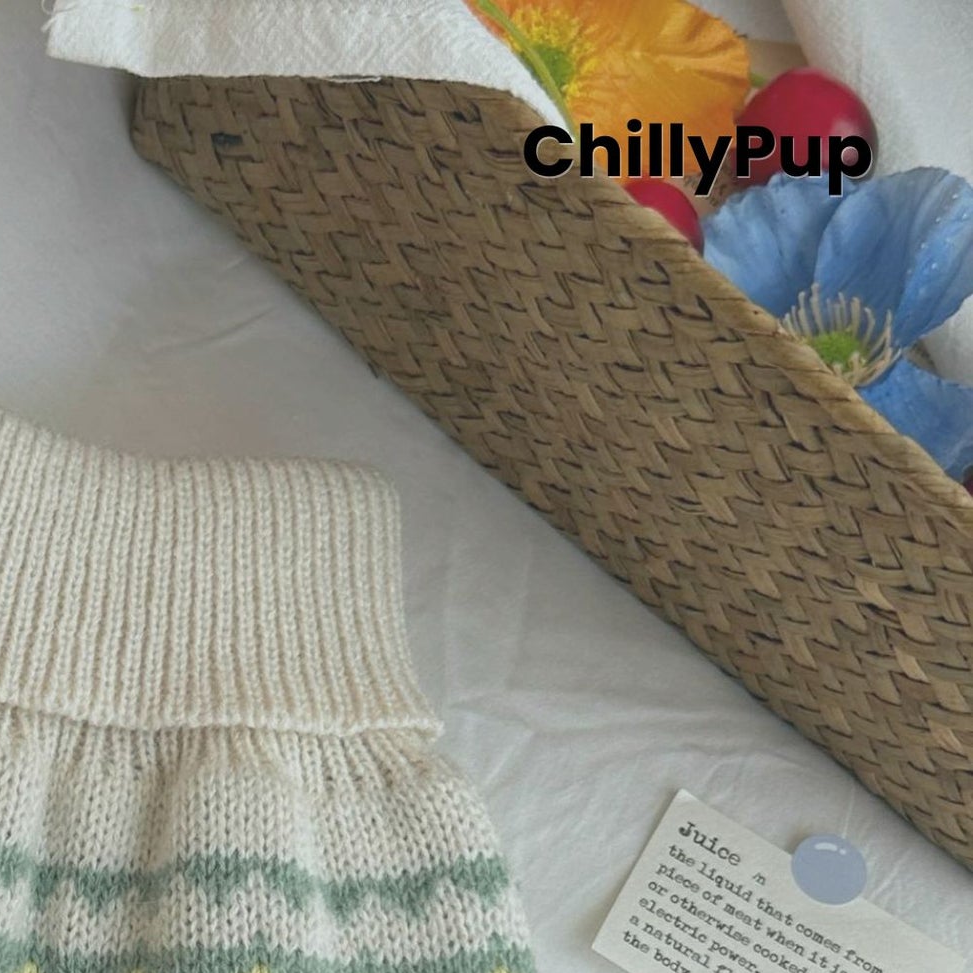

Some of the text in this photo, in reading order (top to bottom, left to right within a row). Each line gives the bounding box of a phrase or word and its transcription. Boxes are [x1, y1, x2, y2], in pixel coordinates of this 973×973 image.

[678, 821, 741, 866] Juice
[639, 898, 707, 943] electric
[648, 882, 668, 896] or
[670, 894, 750, 946] otherwise
[656, 864, 700, 893] piece
[702, 891, 723, 905] of
[723, 904, 763, 930] meat
[767, 927, 805, 956] when
[808, 952, 828, 968] it
[669, 845, 695, 866] the
[698, 862, 753, 902] liquid
[757, 898, 793, 926] that
[796, 924, 841, 953] comes
[624, 930, 650, 953] the
[629, 916, 639, 926] a
[642, 923, 710, 968] natural
